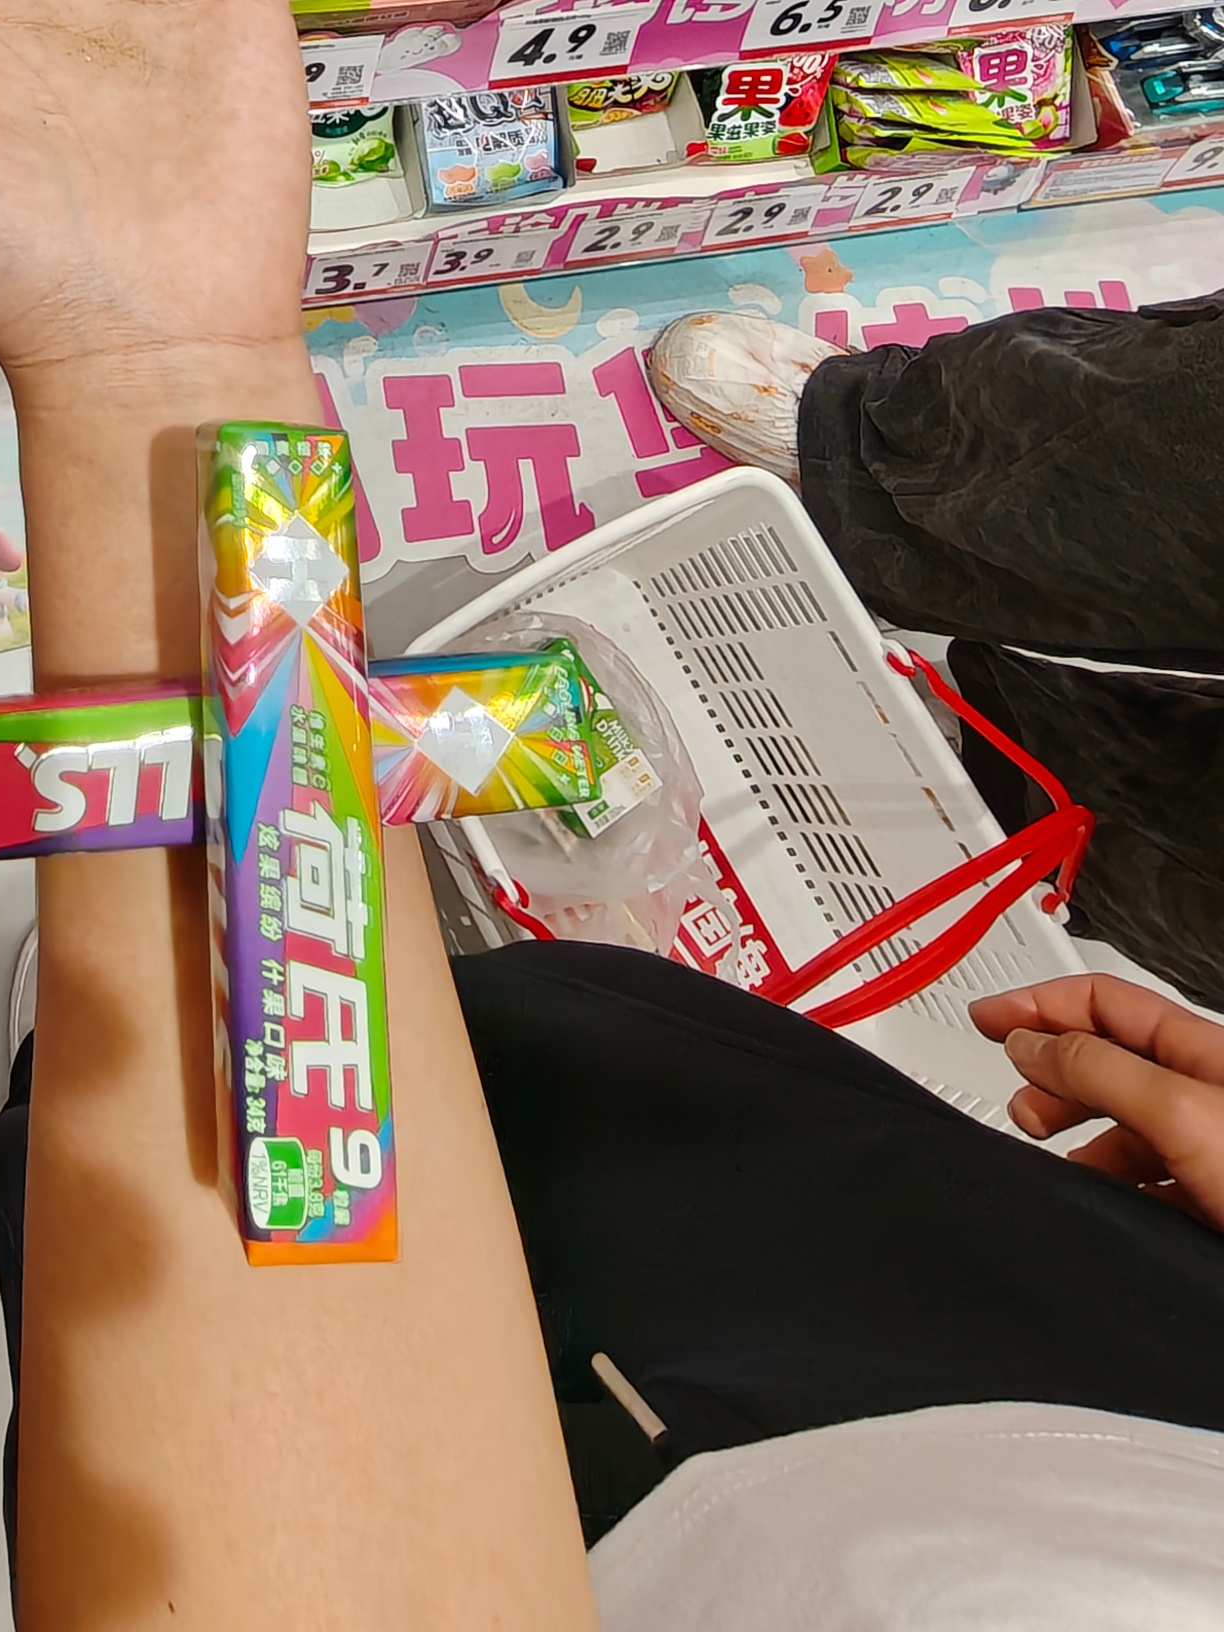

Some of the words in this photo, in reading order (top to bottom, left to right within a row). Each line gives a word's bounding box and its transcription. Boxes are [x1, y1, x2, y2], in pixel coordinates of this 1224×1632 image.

[506, 21, 598, 67] 4.9
[716, 202, 786, 237] 2.9
[864, 182, 934, 216] 2.9
[581, 218, 655, 253] 2.9
[315, 261, 390, 295] 3.7
[433, 245, 494, 275] 3.9
[381, 362, 593, 556] 玩
[16, 726, 198, 836] LLS
[255, 821, 284, 943] 炫果缤纷
[280, 798, 374, 1114] 荷氏
[258, 956, 289, 1083] 什果口味
